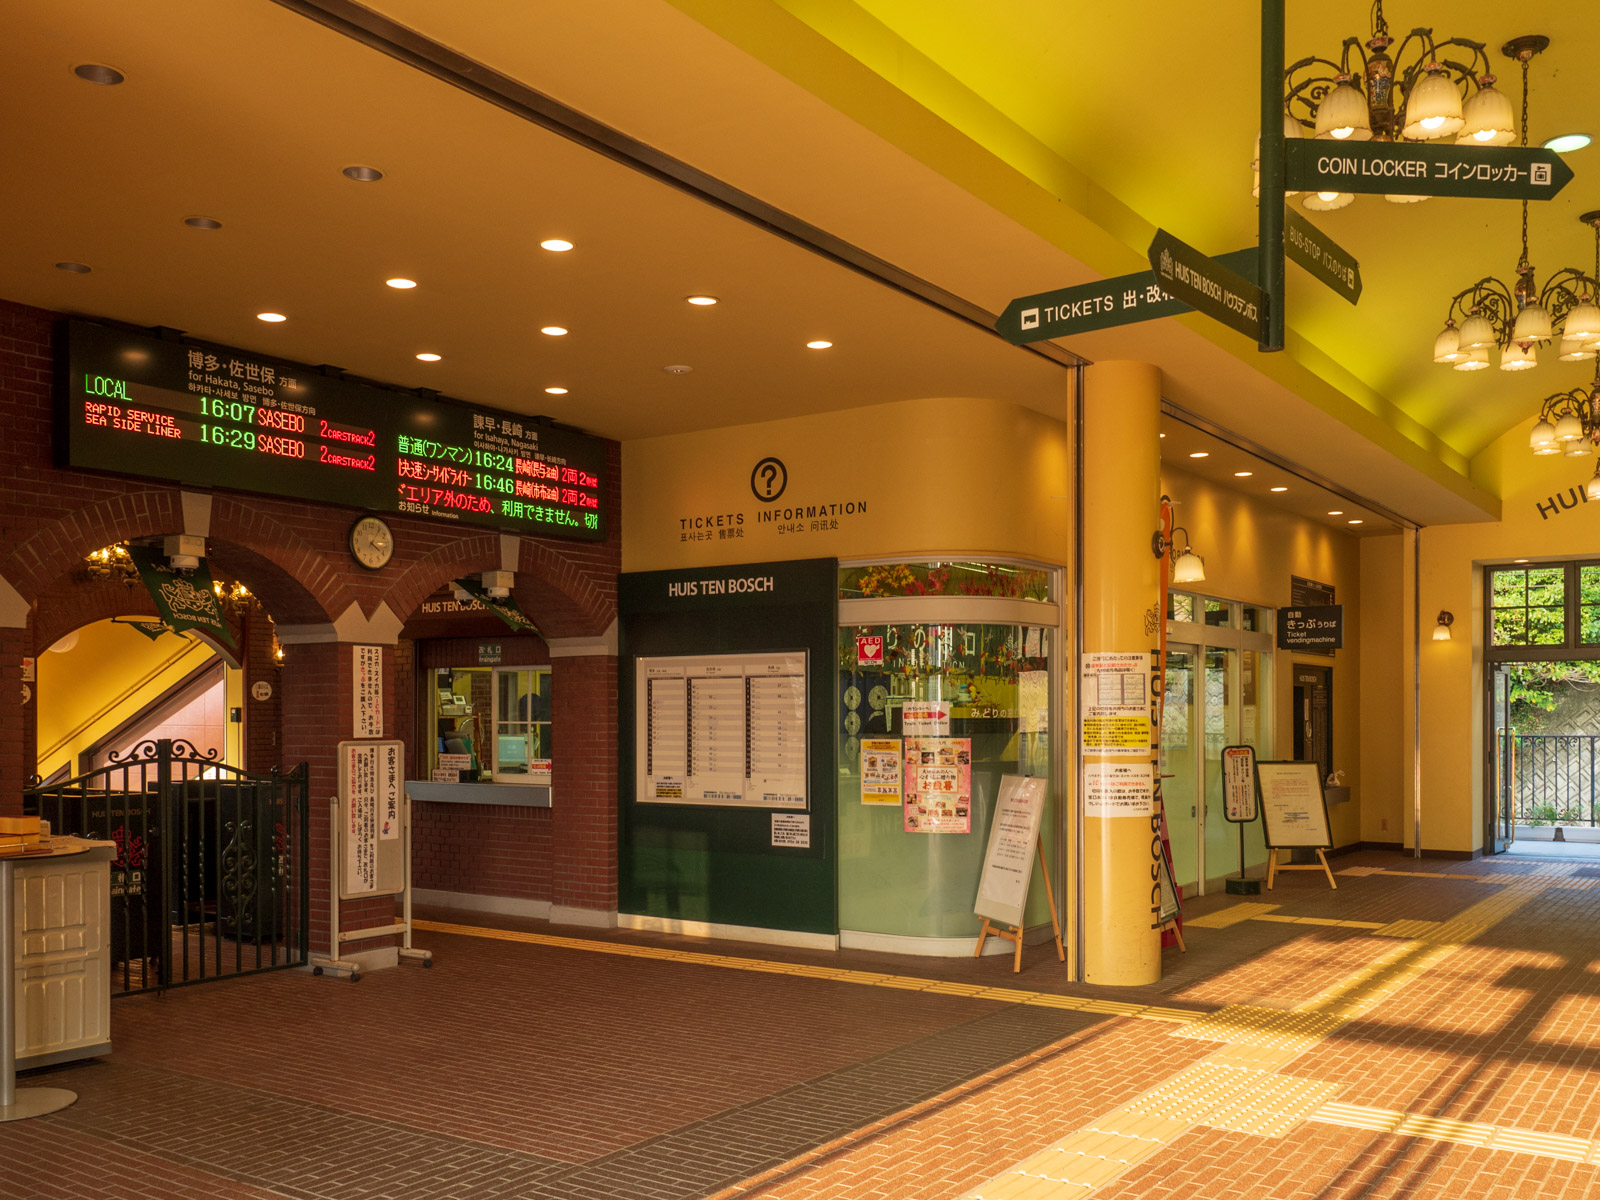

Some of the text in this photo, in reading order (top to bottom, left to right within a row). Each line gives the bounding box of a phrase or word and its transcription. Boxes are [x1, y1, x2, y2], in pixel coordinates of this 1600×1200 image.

[1317, 157, 1528, 182] COIN LOCKER コインロッカー
[1289, 225, 1321, 261] BUS-STOP
[1174, 260, 1190, 285] HUIS
[1189, 269, 1202, 292] TEN
[1202, 275, 1222, 302] BOSCH
[1044, 294, 1114, 323] TICKETS
[188, 369, 274, 397] for Hakata, Sasebo
[278, 375, 297, 390] 方面
[85, 373, 133, 401] LOCAL
[200, 396, 256, 424] 16:07
[257, 407, 305, 433] SASEBO
[85, 401, 175, 428] RAPID SERVICE
[85, 414, 182, 440] SEA SIDE LINER
[473, 430, 484, 440] for
[200, 423, 256, 450] 16:29
[257, 434, 305, 459] SASEBO
[398, 434, 473, 465] 普通(ワンマン)
[475, 450, 514, 473] 16:24
[561, 466, 578, 486] 2両
[475, 473, 515, 494] 16:46
[561, 487, 578, 506] 2両
[1535, 484, 1589, 521] HUI
[398, 500, 430, 515] お知らせ
[680, 500, 868, 530] TICKETS INFORMATION
[777, 522, 805, 535] 안내소
[669, 576, 774, 597] HUIS TEN BOSCH
[421, 601, 442, 613] HUIS
[443, 600, 460, 612] TEN
[860, 636, 881, 645] AED
[1286, 636, 1336, 645] vendingmachine
[387, 747, 396, 820] お客さまへ ご案内
